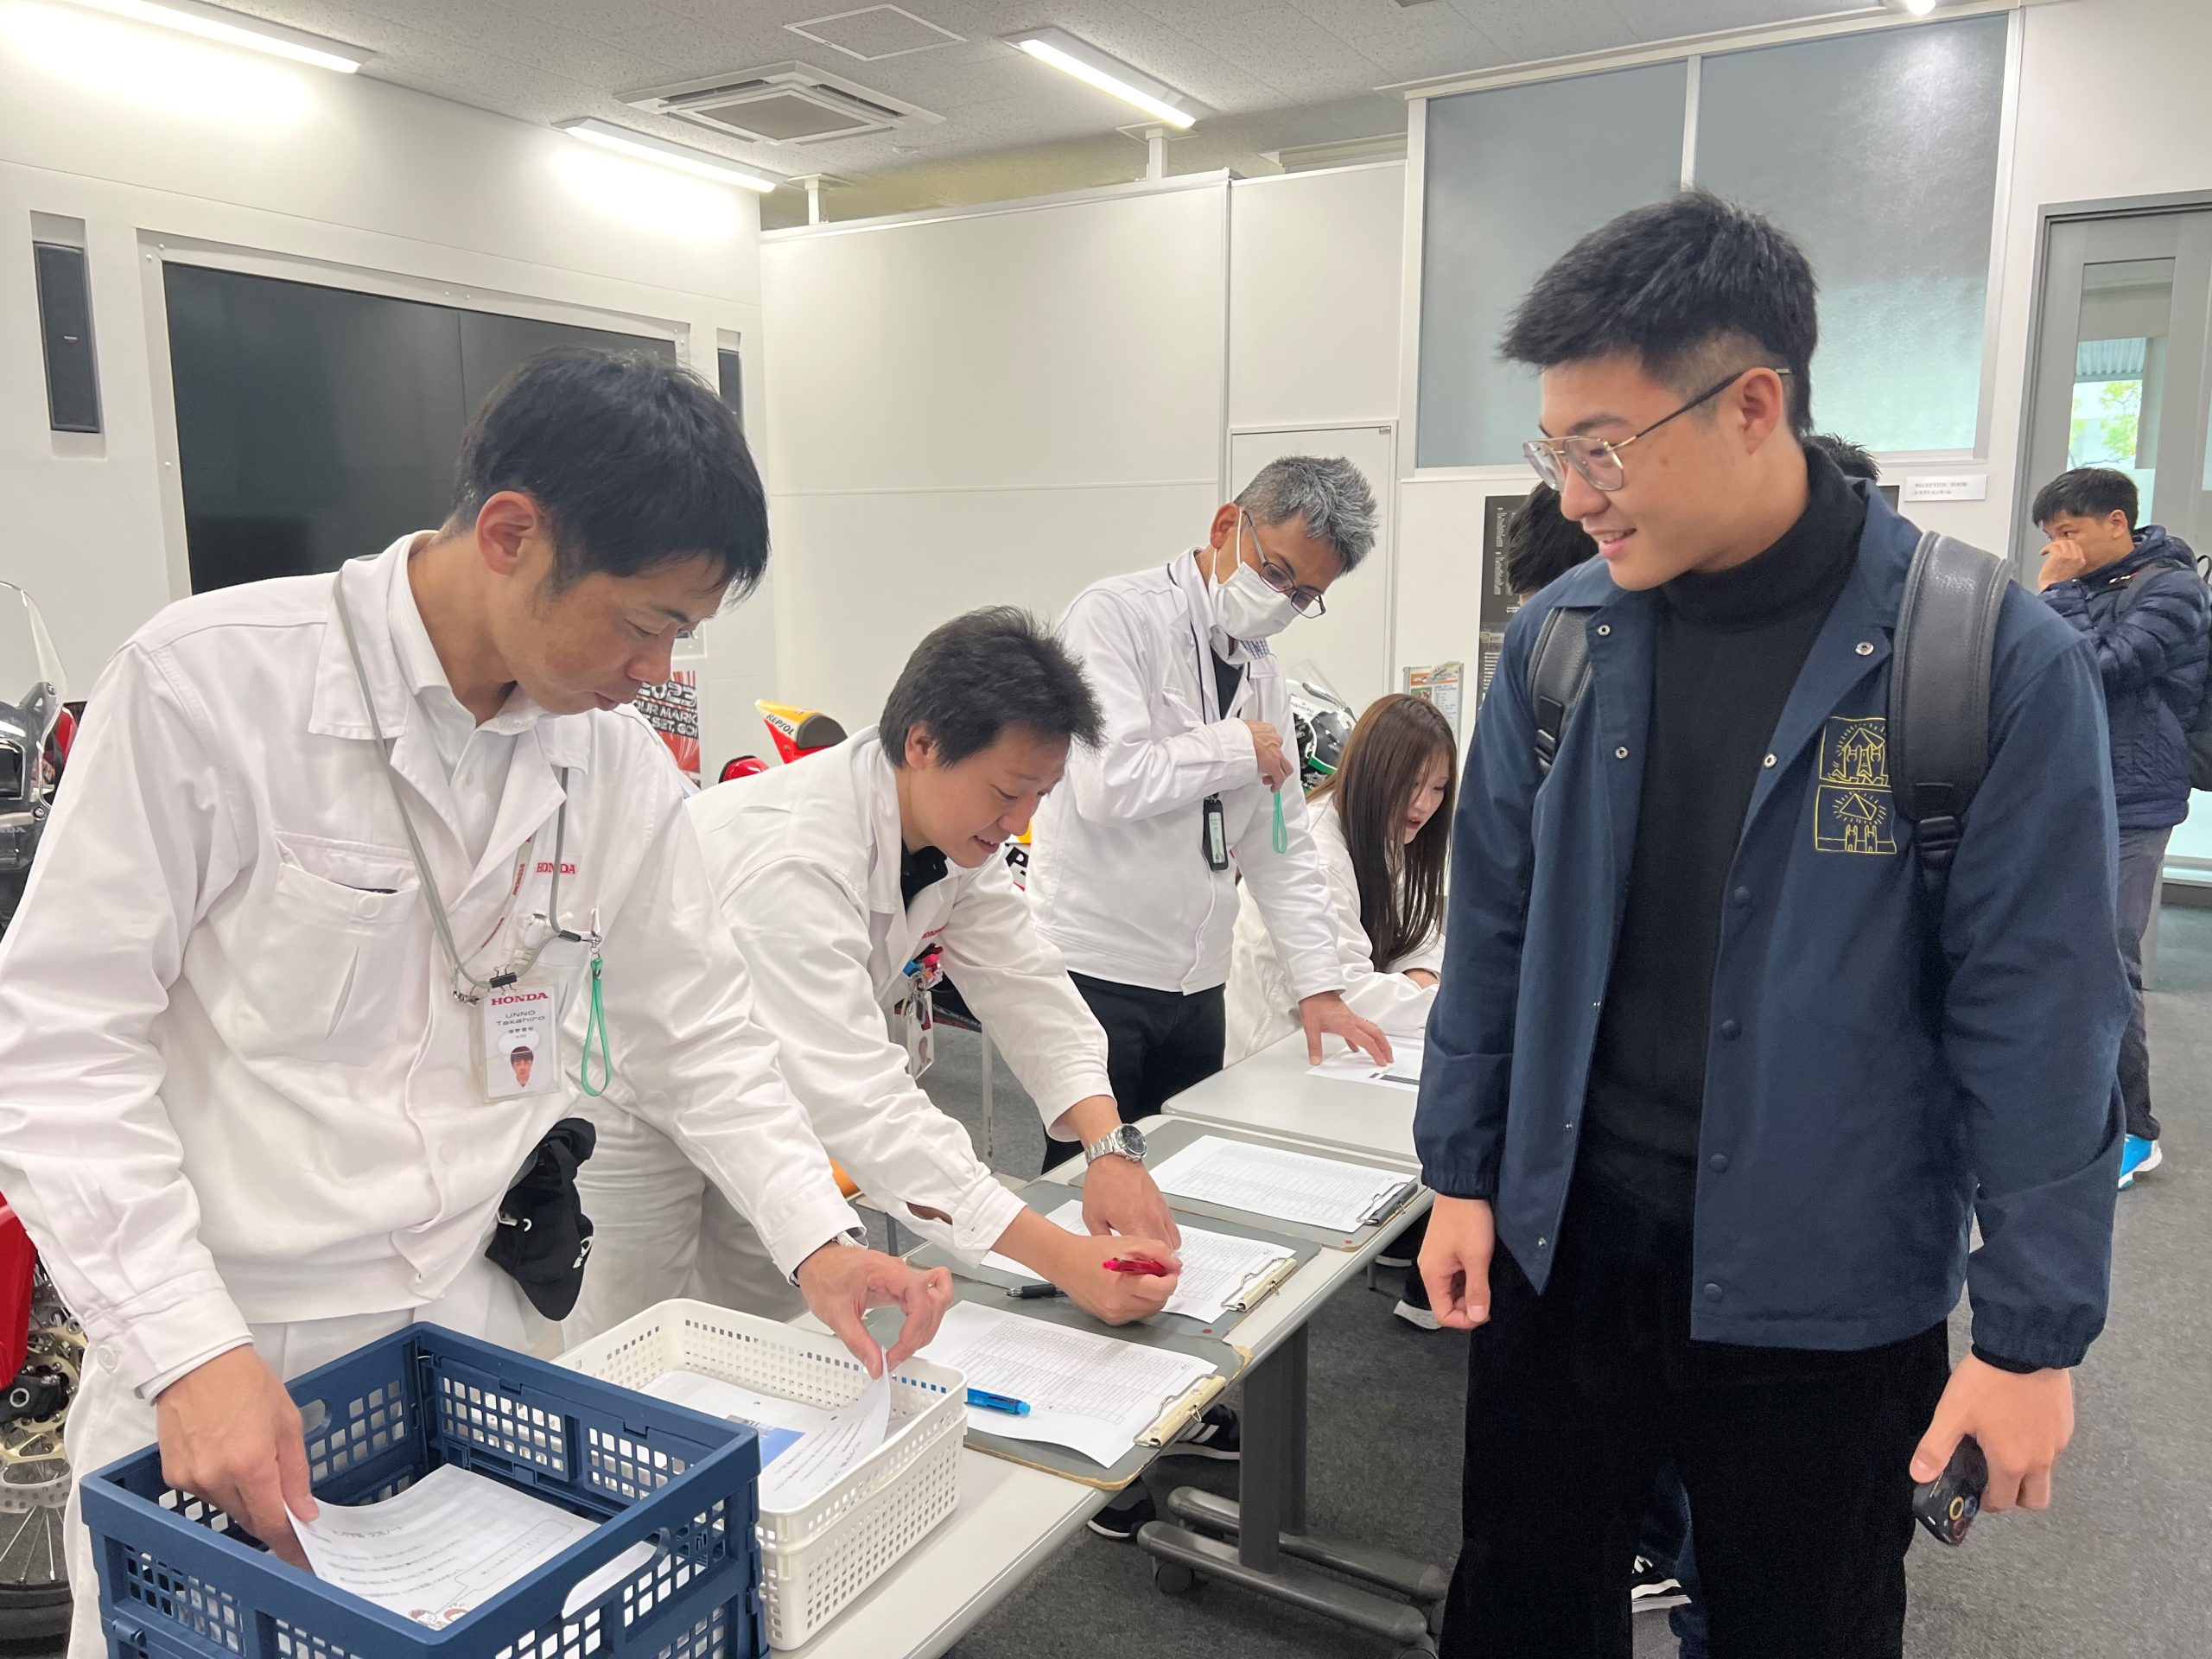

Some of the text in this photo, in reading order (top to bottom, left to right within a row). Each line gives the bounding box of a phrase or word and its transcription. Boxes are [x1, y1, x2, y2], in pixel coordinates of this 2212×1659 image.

[766, 713, 796, 735] REPSOL
[537, 862, 575, 874] HONDA
[491, 992, 550, 1006] HONDA
[505, 1010, 536, 1019] UNNO
[496, 1016, 545, 1027] Takahiro
